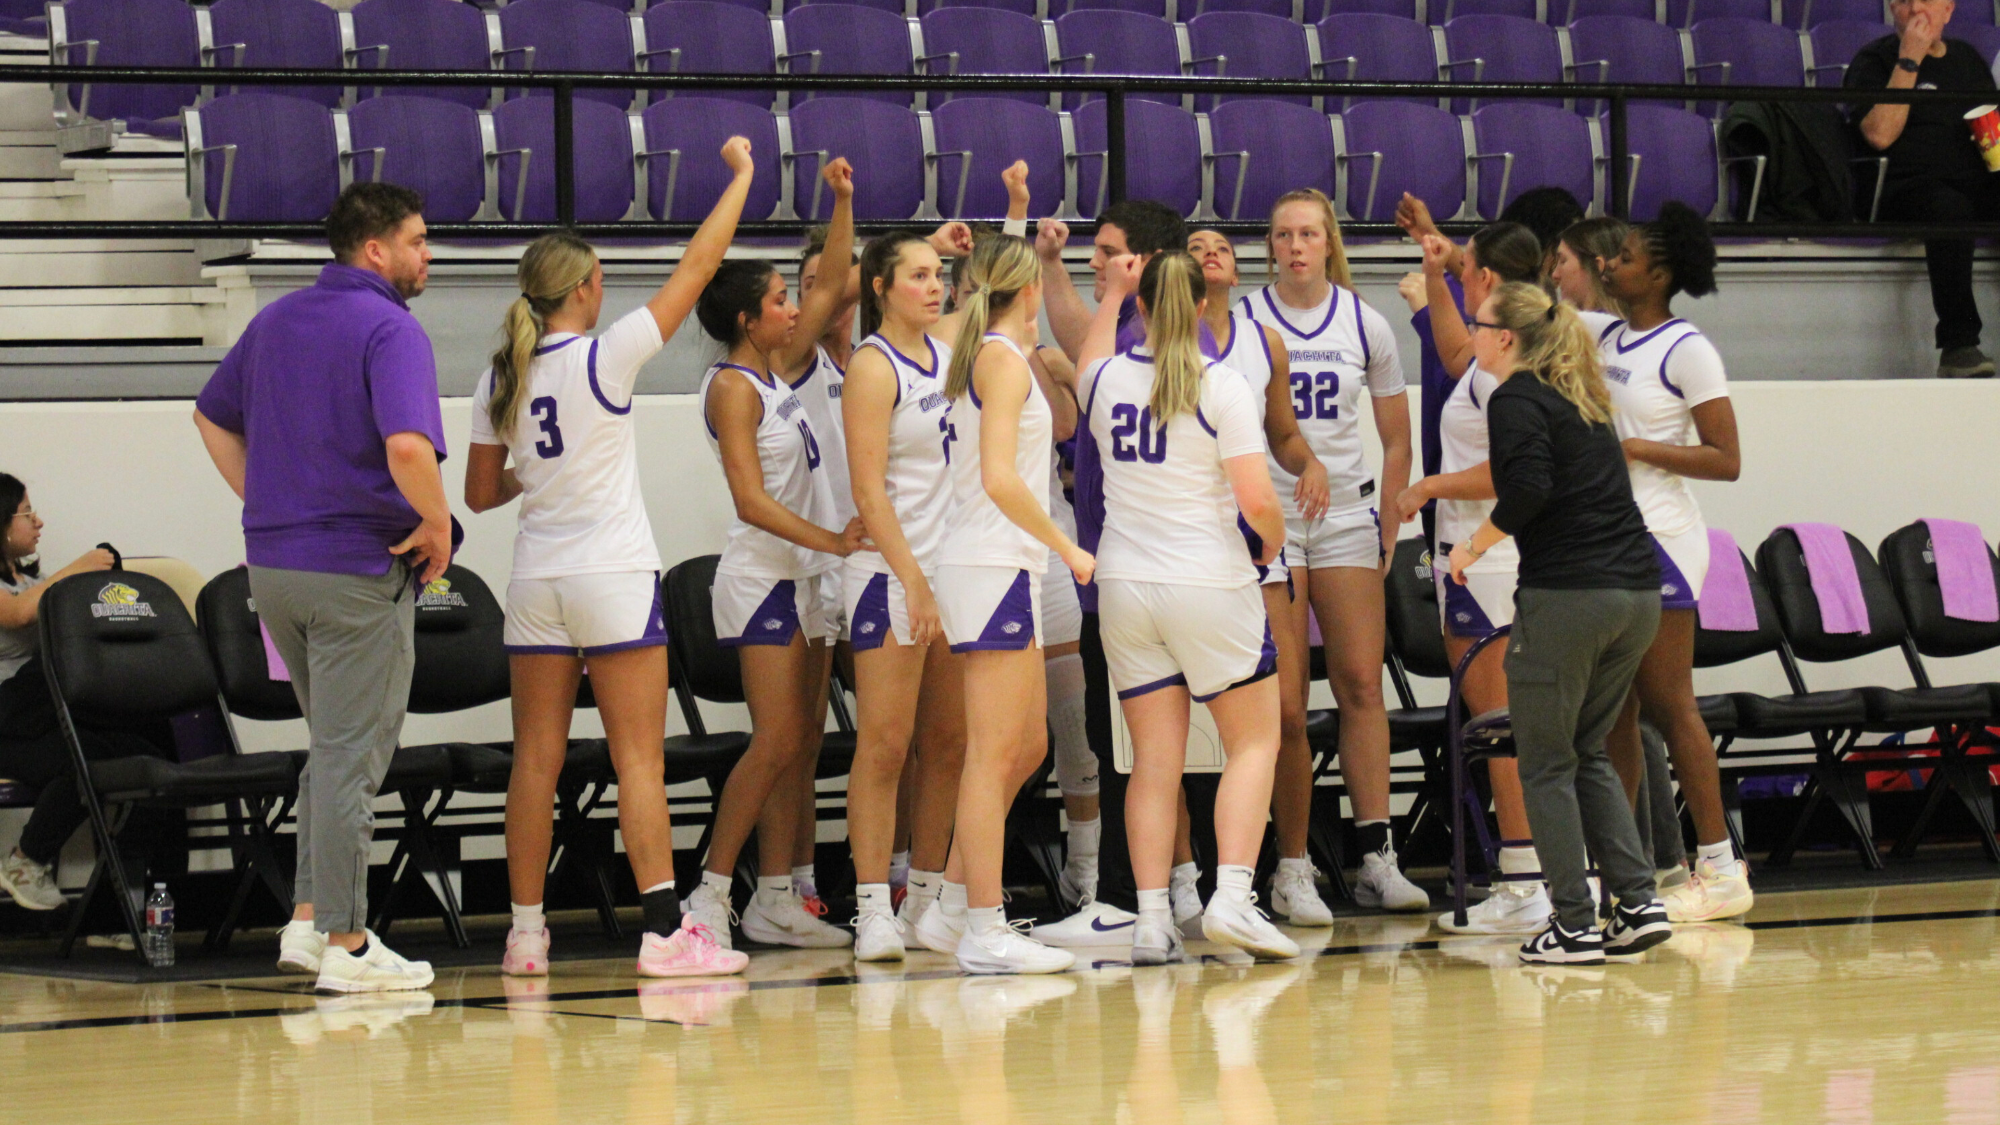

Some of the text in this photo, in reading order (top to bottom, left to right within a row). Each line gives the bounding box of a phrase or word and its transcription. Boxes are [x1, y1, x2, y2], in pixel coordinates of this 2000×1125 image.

[1289, 371, 1339, 420] 32
[530, 395, 565, 460] 3
[1111, 402, 1167, 465] 20
[91, 602, 156, 618] OUACHITA
